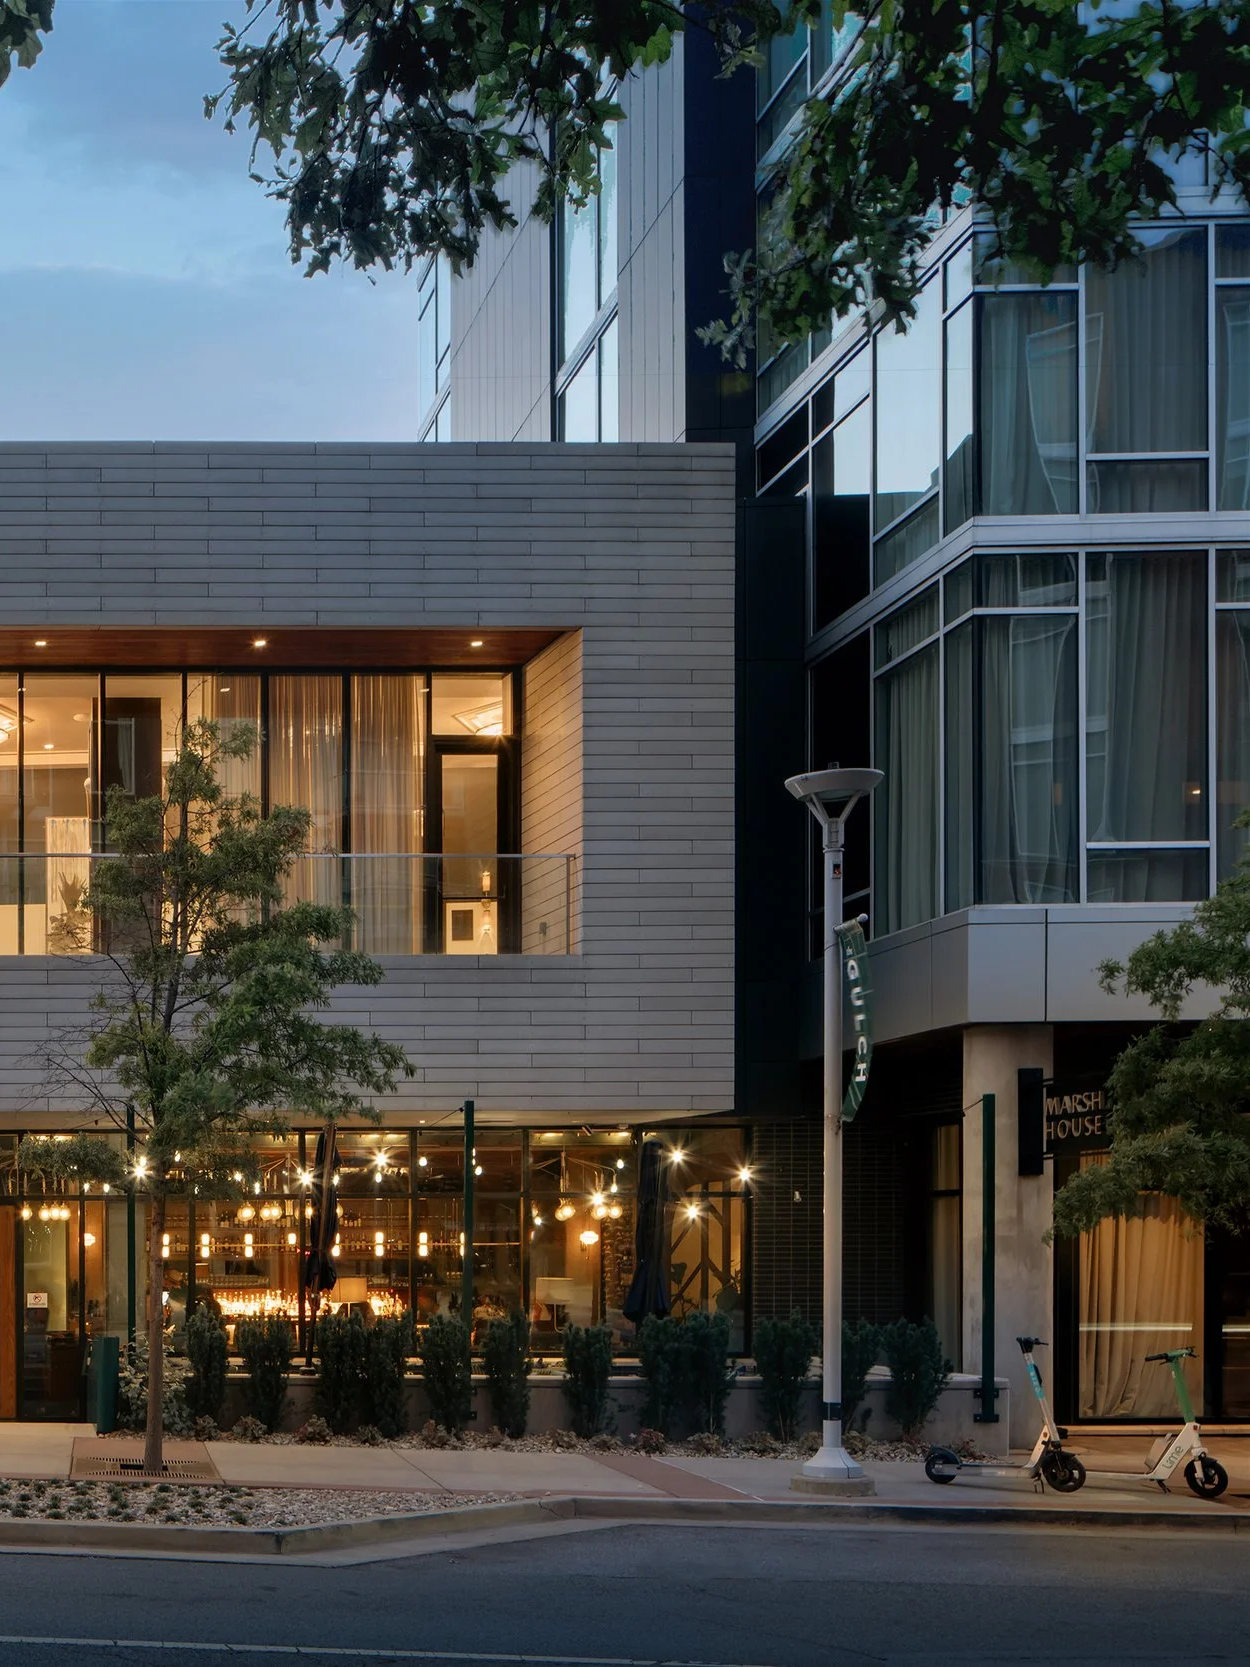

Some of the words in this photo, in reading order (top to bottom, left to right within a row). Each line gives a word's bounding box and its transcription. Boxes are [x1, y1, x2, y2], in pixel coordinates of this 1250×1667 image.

[847, 959, 868, 1082] GULCH
[1046, 1090, 1102, 1115] MARSH
[1045, 1115, 1102, 1140] HOUSE
